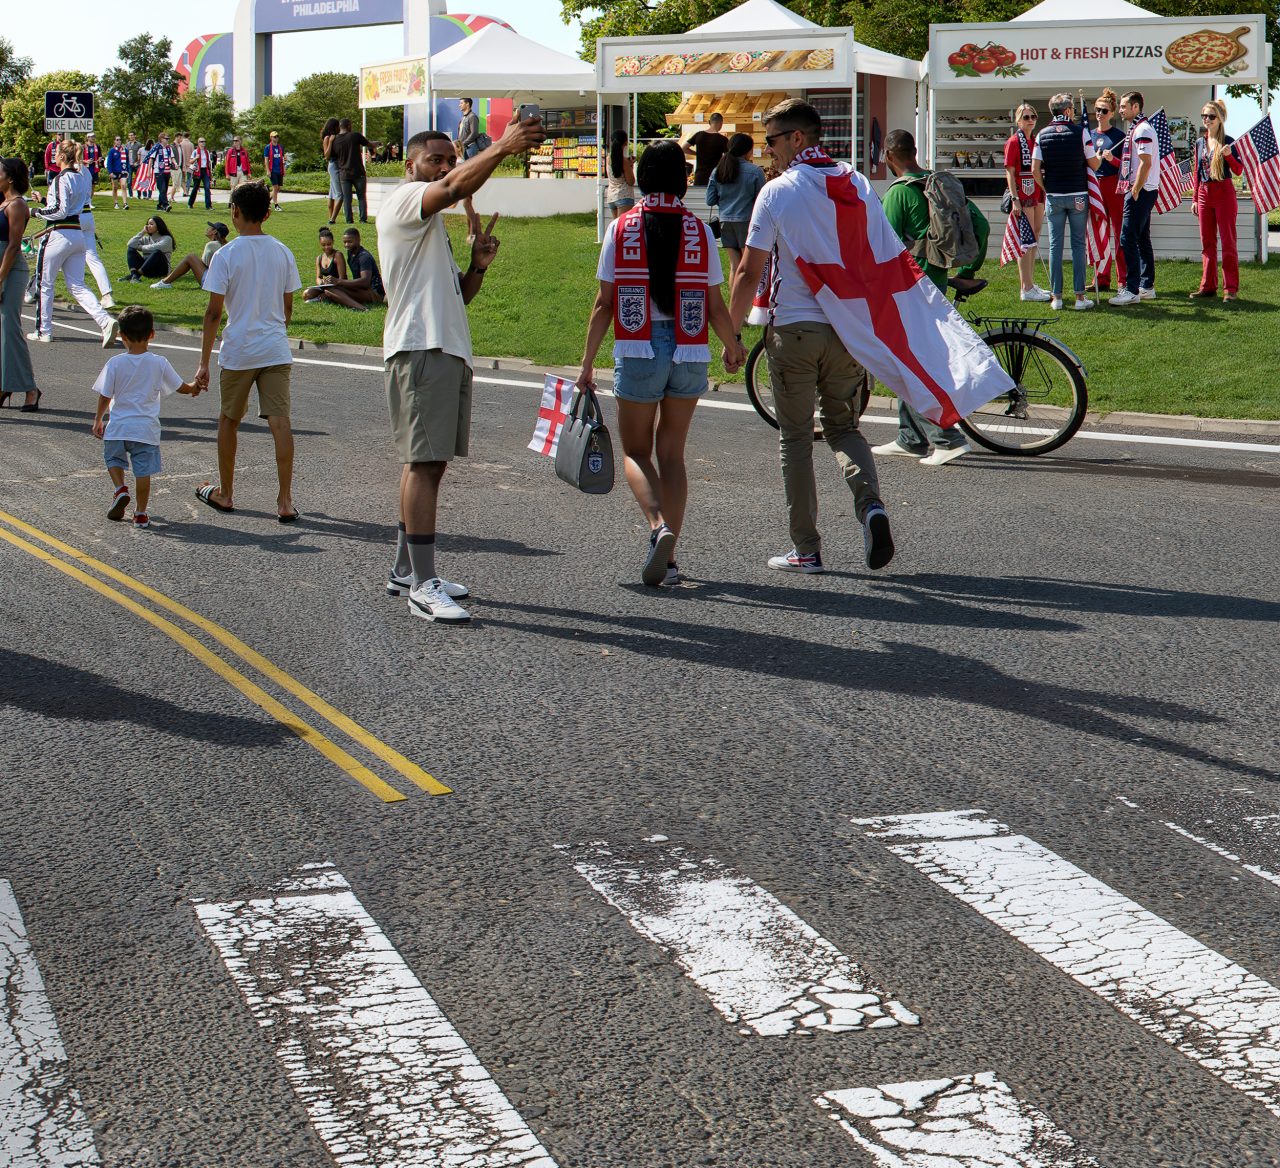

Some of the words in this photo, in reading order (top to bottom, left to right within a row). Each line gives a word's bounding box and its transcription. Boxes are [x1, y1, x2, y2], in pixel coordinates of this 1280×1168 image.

[293, 0, 360, 17] PHILADELPHIA
[1020, 48, 1048, 60] HOT
[1051, 48, 1061, 60] &
[1065, 46, 1109, 60] FRESH
[1112, 45, 1163, 59] PIZZAS
[46, 119, 66, 130] BIKE
[68, 119, 92, 131] LANE
